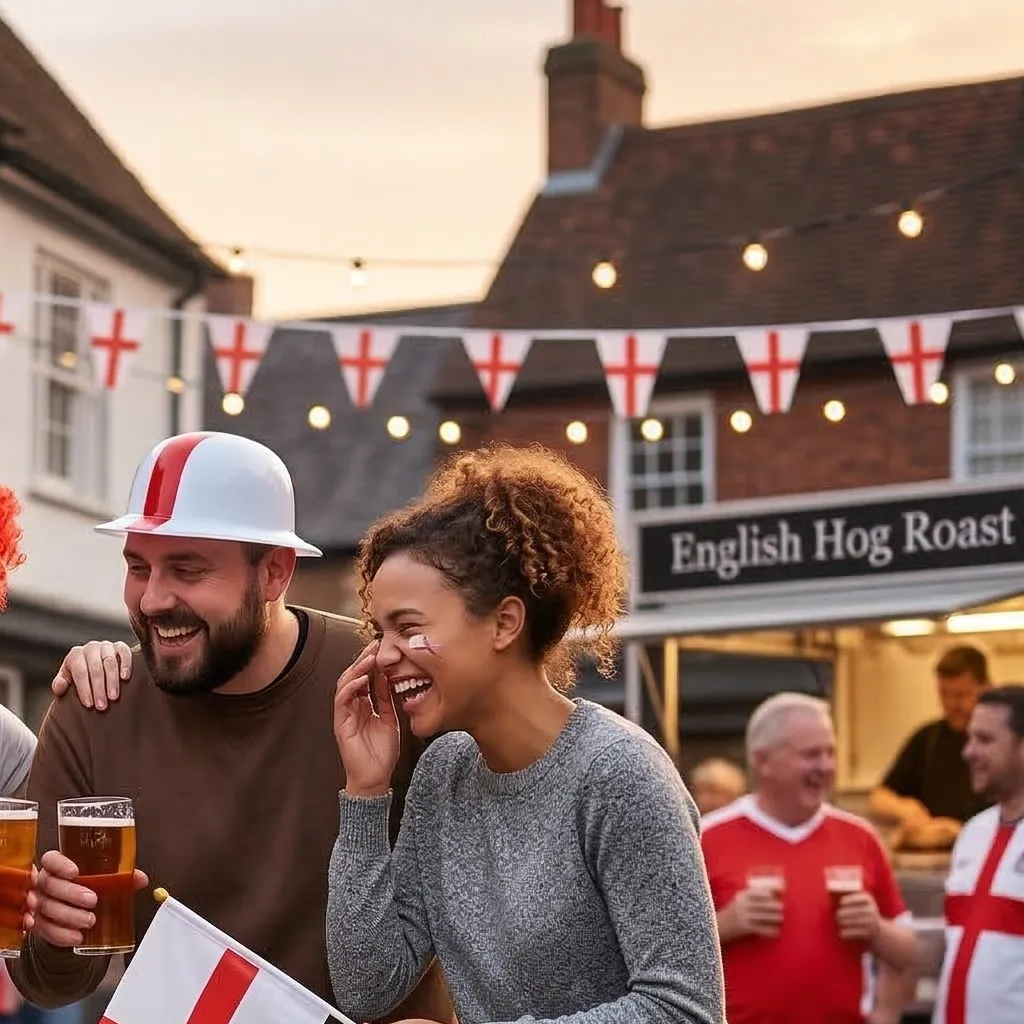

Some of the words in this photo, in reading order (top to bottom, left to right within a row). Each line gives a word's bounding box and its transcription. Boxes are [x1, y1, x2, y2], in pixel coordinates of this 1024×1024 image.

[670, 521, 802, 580] English
[812, 517, 893, 567] Hog
[901, 505, 1017, 554] Roast
